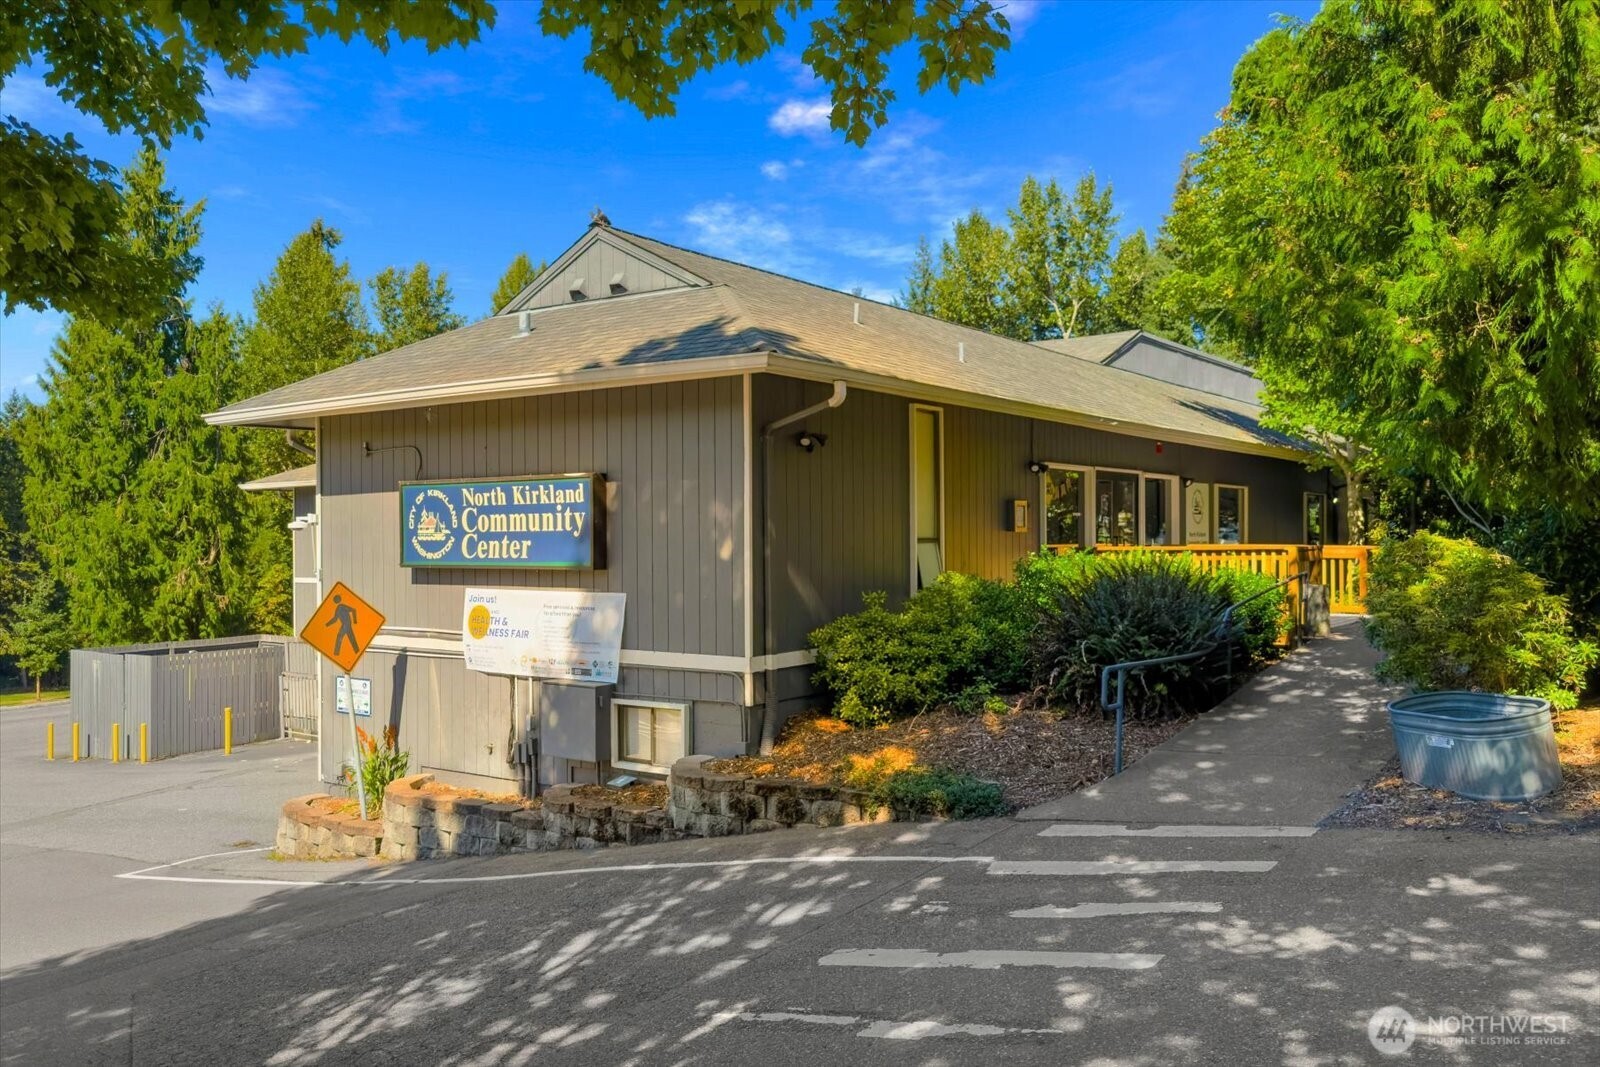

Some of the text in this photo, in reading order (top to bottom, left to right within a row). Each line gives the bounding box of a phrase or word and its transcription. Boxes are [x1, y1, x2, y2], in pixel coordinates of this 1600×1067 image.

[461, 483, 585, 507] North Kirkland
[408, 489, 458, 529] CITY OF KIRKLAND
[461, 505, 586, 537] Community
[411, 535, 455, 560] WASHINGTON
[461, 533, 532, 559] Center
[468, 593, 497, 604] Join us!
[472, 615, 508, 626] HEALTH &
[510, 629, 530, 639] FAIR
